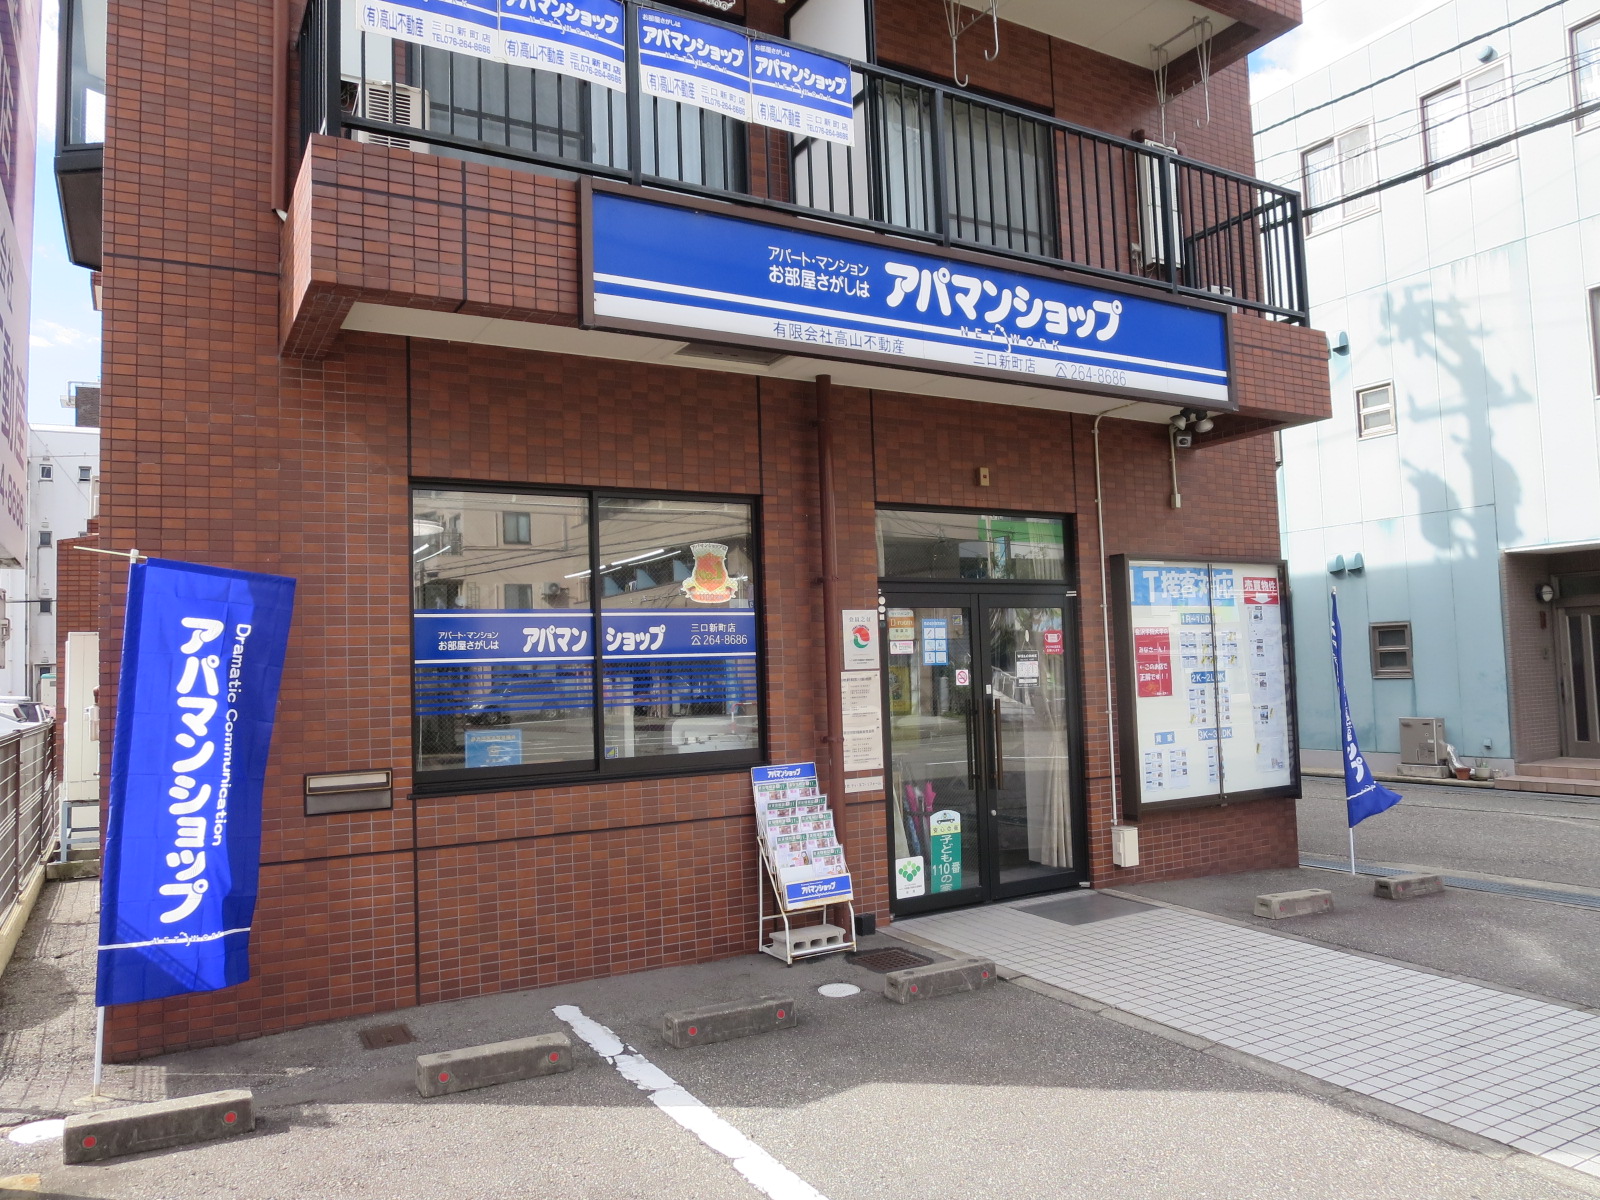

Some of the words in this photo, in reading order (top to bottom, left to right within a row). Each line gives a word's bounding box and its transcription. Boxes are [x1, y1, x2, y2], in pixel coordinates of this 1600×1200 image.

[642, 26, 745, 67] アパマンショップ
[755, 56, 847, 95] アパマンショップ
[768, 246, 869, 276] アパート・マンション
[769, 265, 870, 298] お部屋さがしは
[885, 261, 1122, 341] アパマンショップ
[773, 321, 905, 354] 有限会社高山不動産
[973, 351, 1036, 374] 三口新町店
[1070, 364, 1127, 387] 264-8686
[438, 640, 499, 651] お部屋さがしは
[523, 625, 587, 652] アパマン
[606, 624, 666, 651] ショップ
[691, 623, 736, 633] 三口新町店
[703, 634, 748, 645] 264-8686
[227, 624, 251, 703] Dramatic
[160, 617, 224, 923] アパマンショップ
[211, 709, 238, 846] Communication
[801, 881, 836, 895] アパマンショップ
